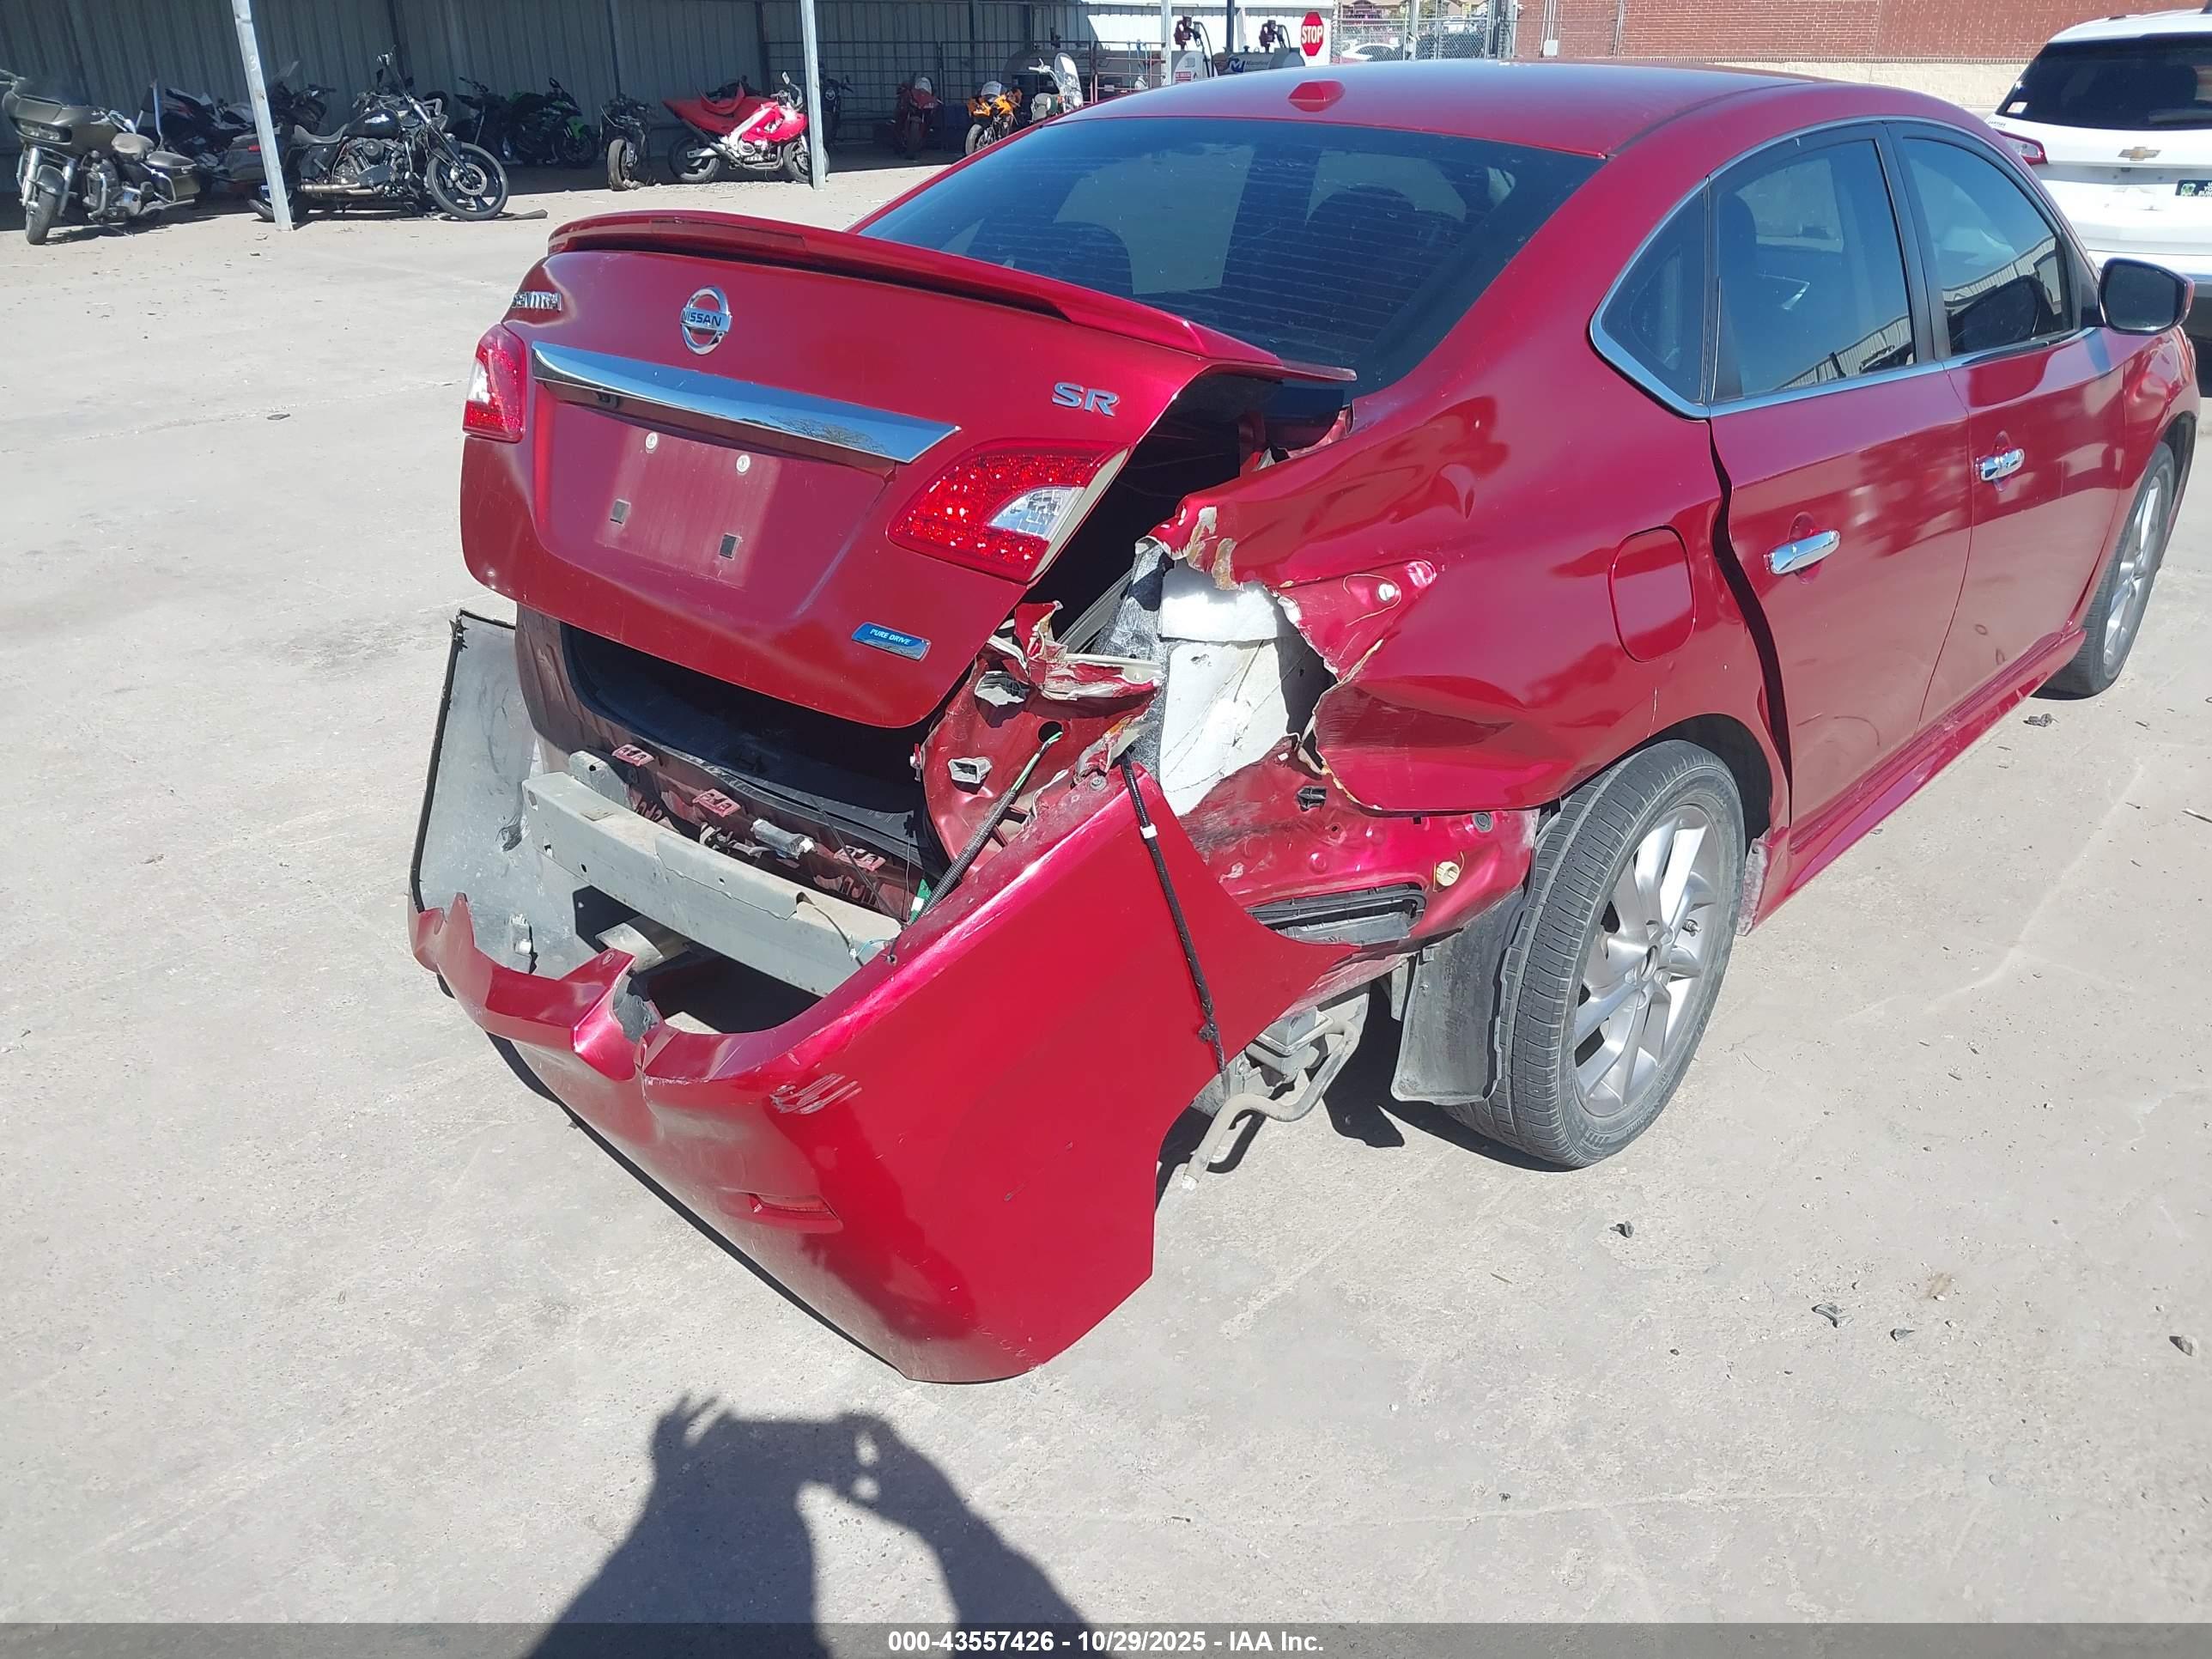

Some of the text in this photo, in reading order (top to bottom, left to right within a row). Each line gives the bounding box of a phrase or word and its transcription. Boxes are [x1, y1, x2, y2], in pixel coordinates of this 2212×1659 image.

[1301, 25, 1323, 44] STOP
[683, 310, 722, 327] NISSAN
[1051, 381, 1120, 417] SR
[869, 628, 912, 645] PURE DRIVE
